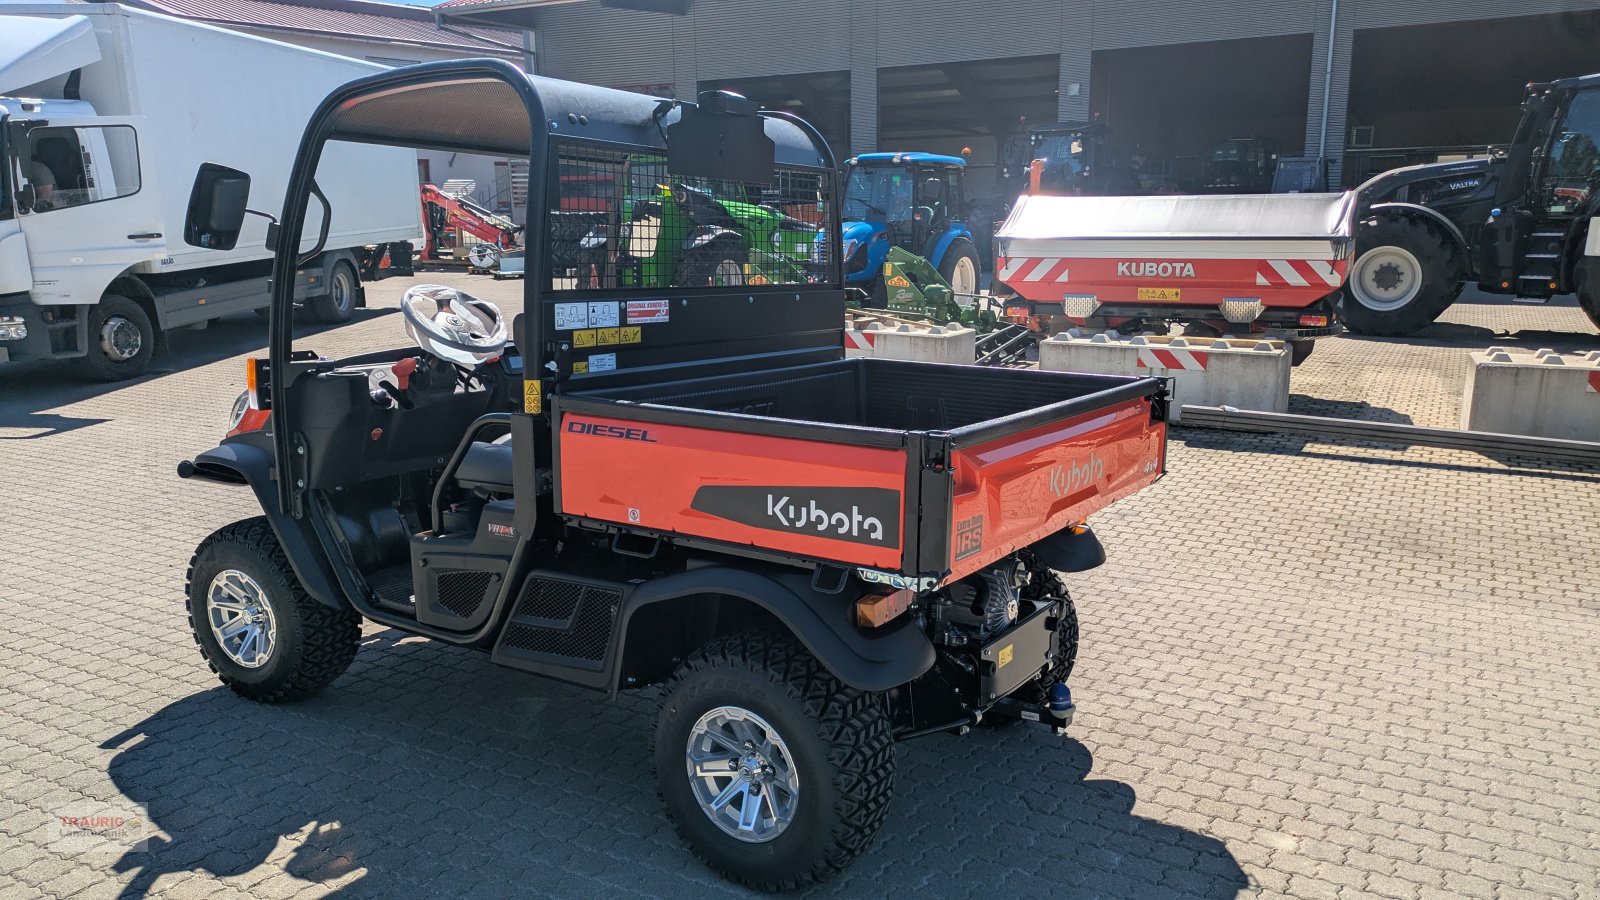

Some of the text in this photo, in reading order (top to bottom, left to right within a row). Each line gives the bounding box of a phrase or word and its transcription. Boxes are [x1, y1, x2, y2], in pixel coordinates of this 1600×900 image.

[1449, 179, 1480, 190] VALTRA
[1117, 261, 1196, 278] KUBOTA
[568, 421, 657, 443] DIESEL
[1049, 452, 1104, 497] Kubota
[767, 493, 883, 541] Kubota
[956, 527, 982, 555] IRS
